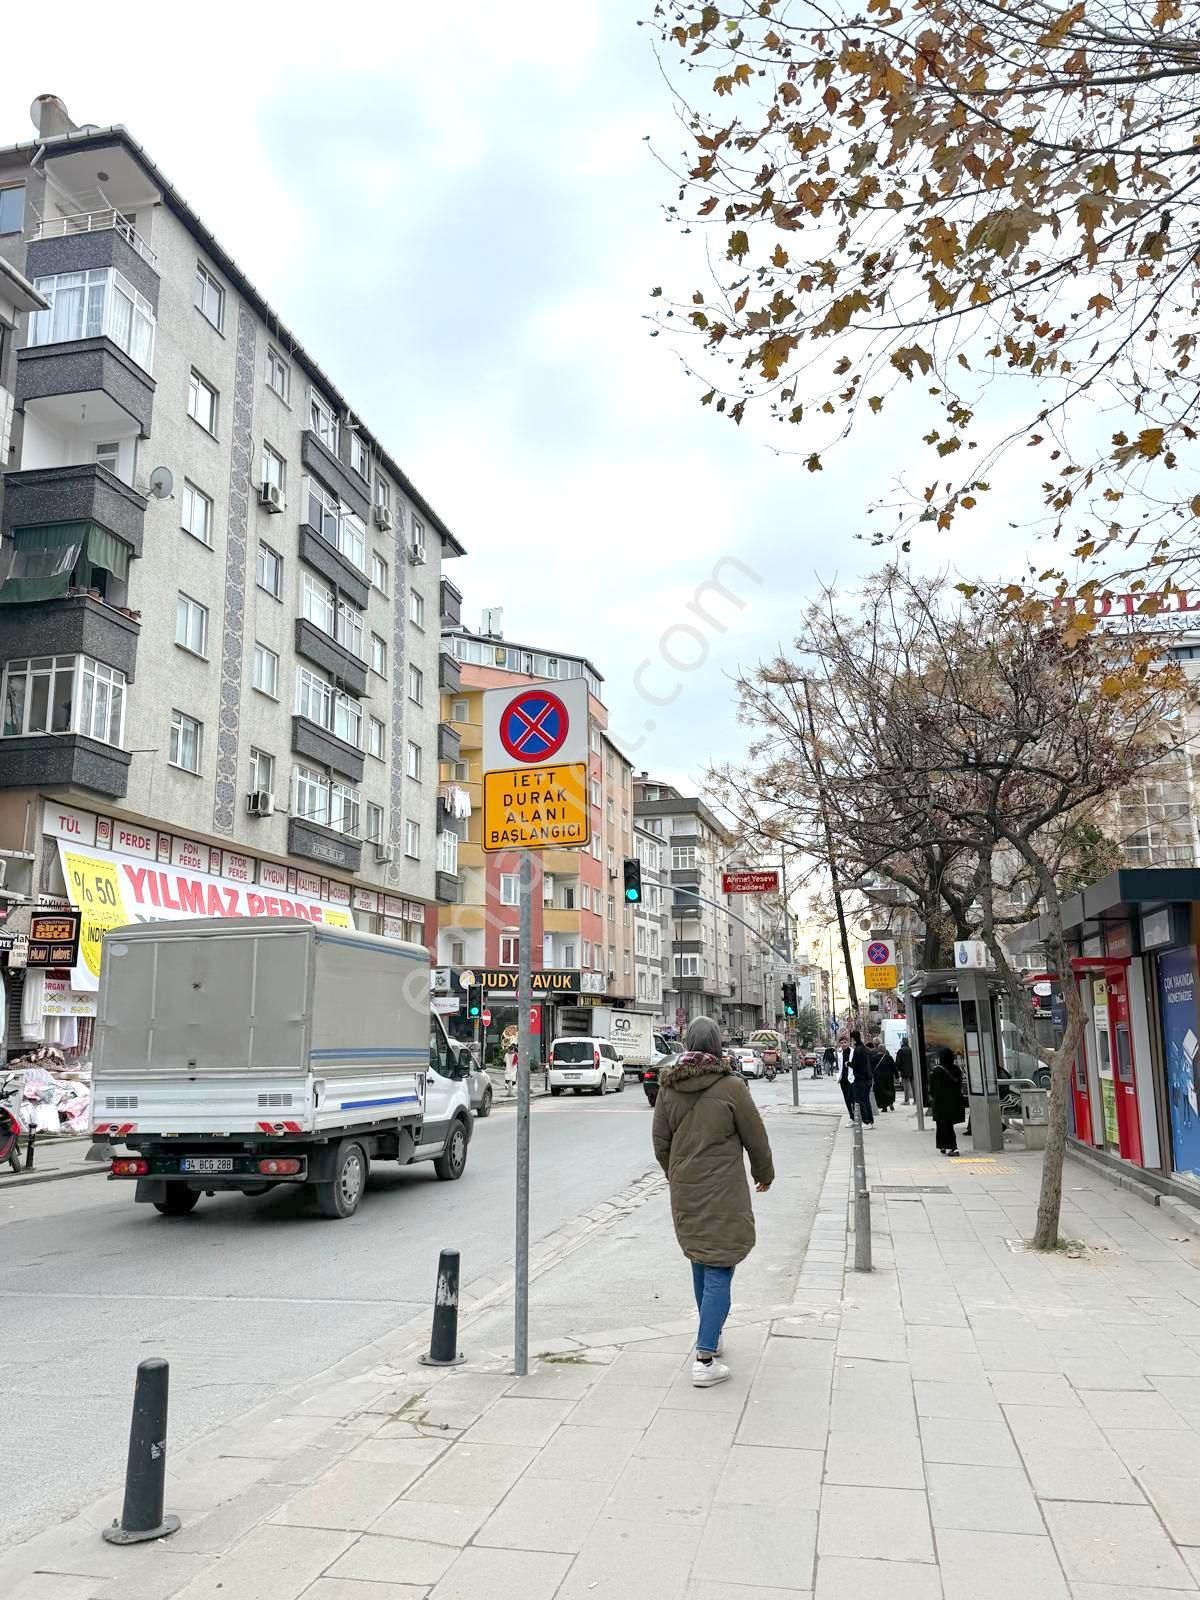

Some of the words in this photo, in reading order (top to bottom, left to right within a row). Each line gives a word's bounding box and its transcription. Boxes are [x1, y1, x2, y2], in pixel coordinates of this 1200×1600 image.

[513, 772, 556, 788] İETT
[503, 789, 567, 807] DURAK
[505, 807, 566, 825] ALANI
[58, 814, 81, 835] TÜL
[119, 831, 151, 851] PERDE
[491, 824, 581, 843] BAŞLANGICI
[183, 842, 199, 855] FON
[179, 854, 201, 869] PERDE
[230, 856, 247, 868] STOR
[228, 866, 248, 880] PERDE
[263, 867, 285, 885] UYGUN
[726, 875, 750, 884] Ahmet
[751, 874, 775, 883] Yesevi
[122, 864, 242, 917] YILMAZ
[736, 883, 765, 891] Caddesi
[480, 973, 519, 989] JUDY
[529, 973, 572, 989] AVUK
[186, 1160, 196, 1170] 34
[199, 1160, 214, 1170] BCG
